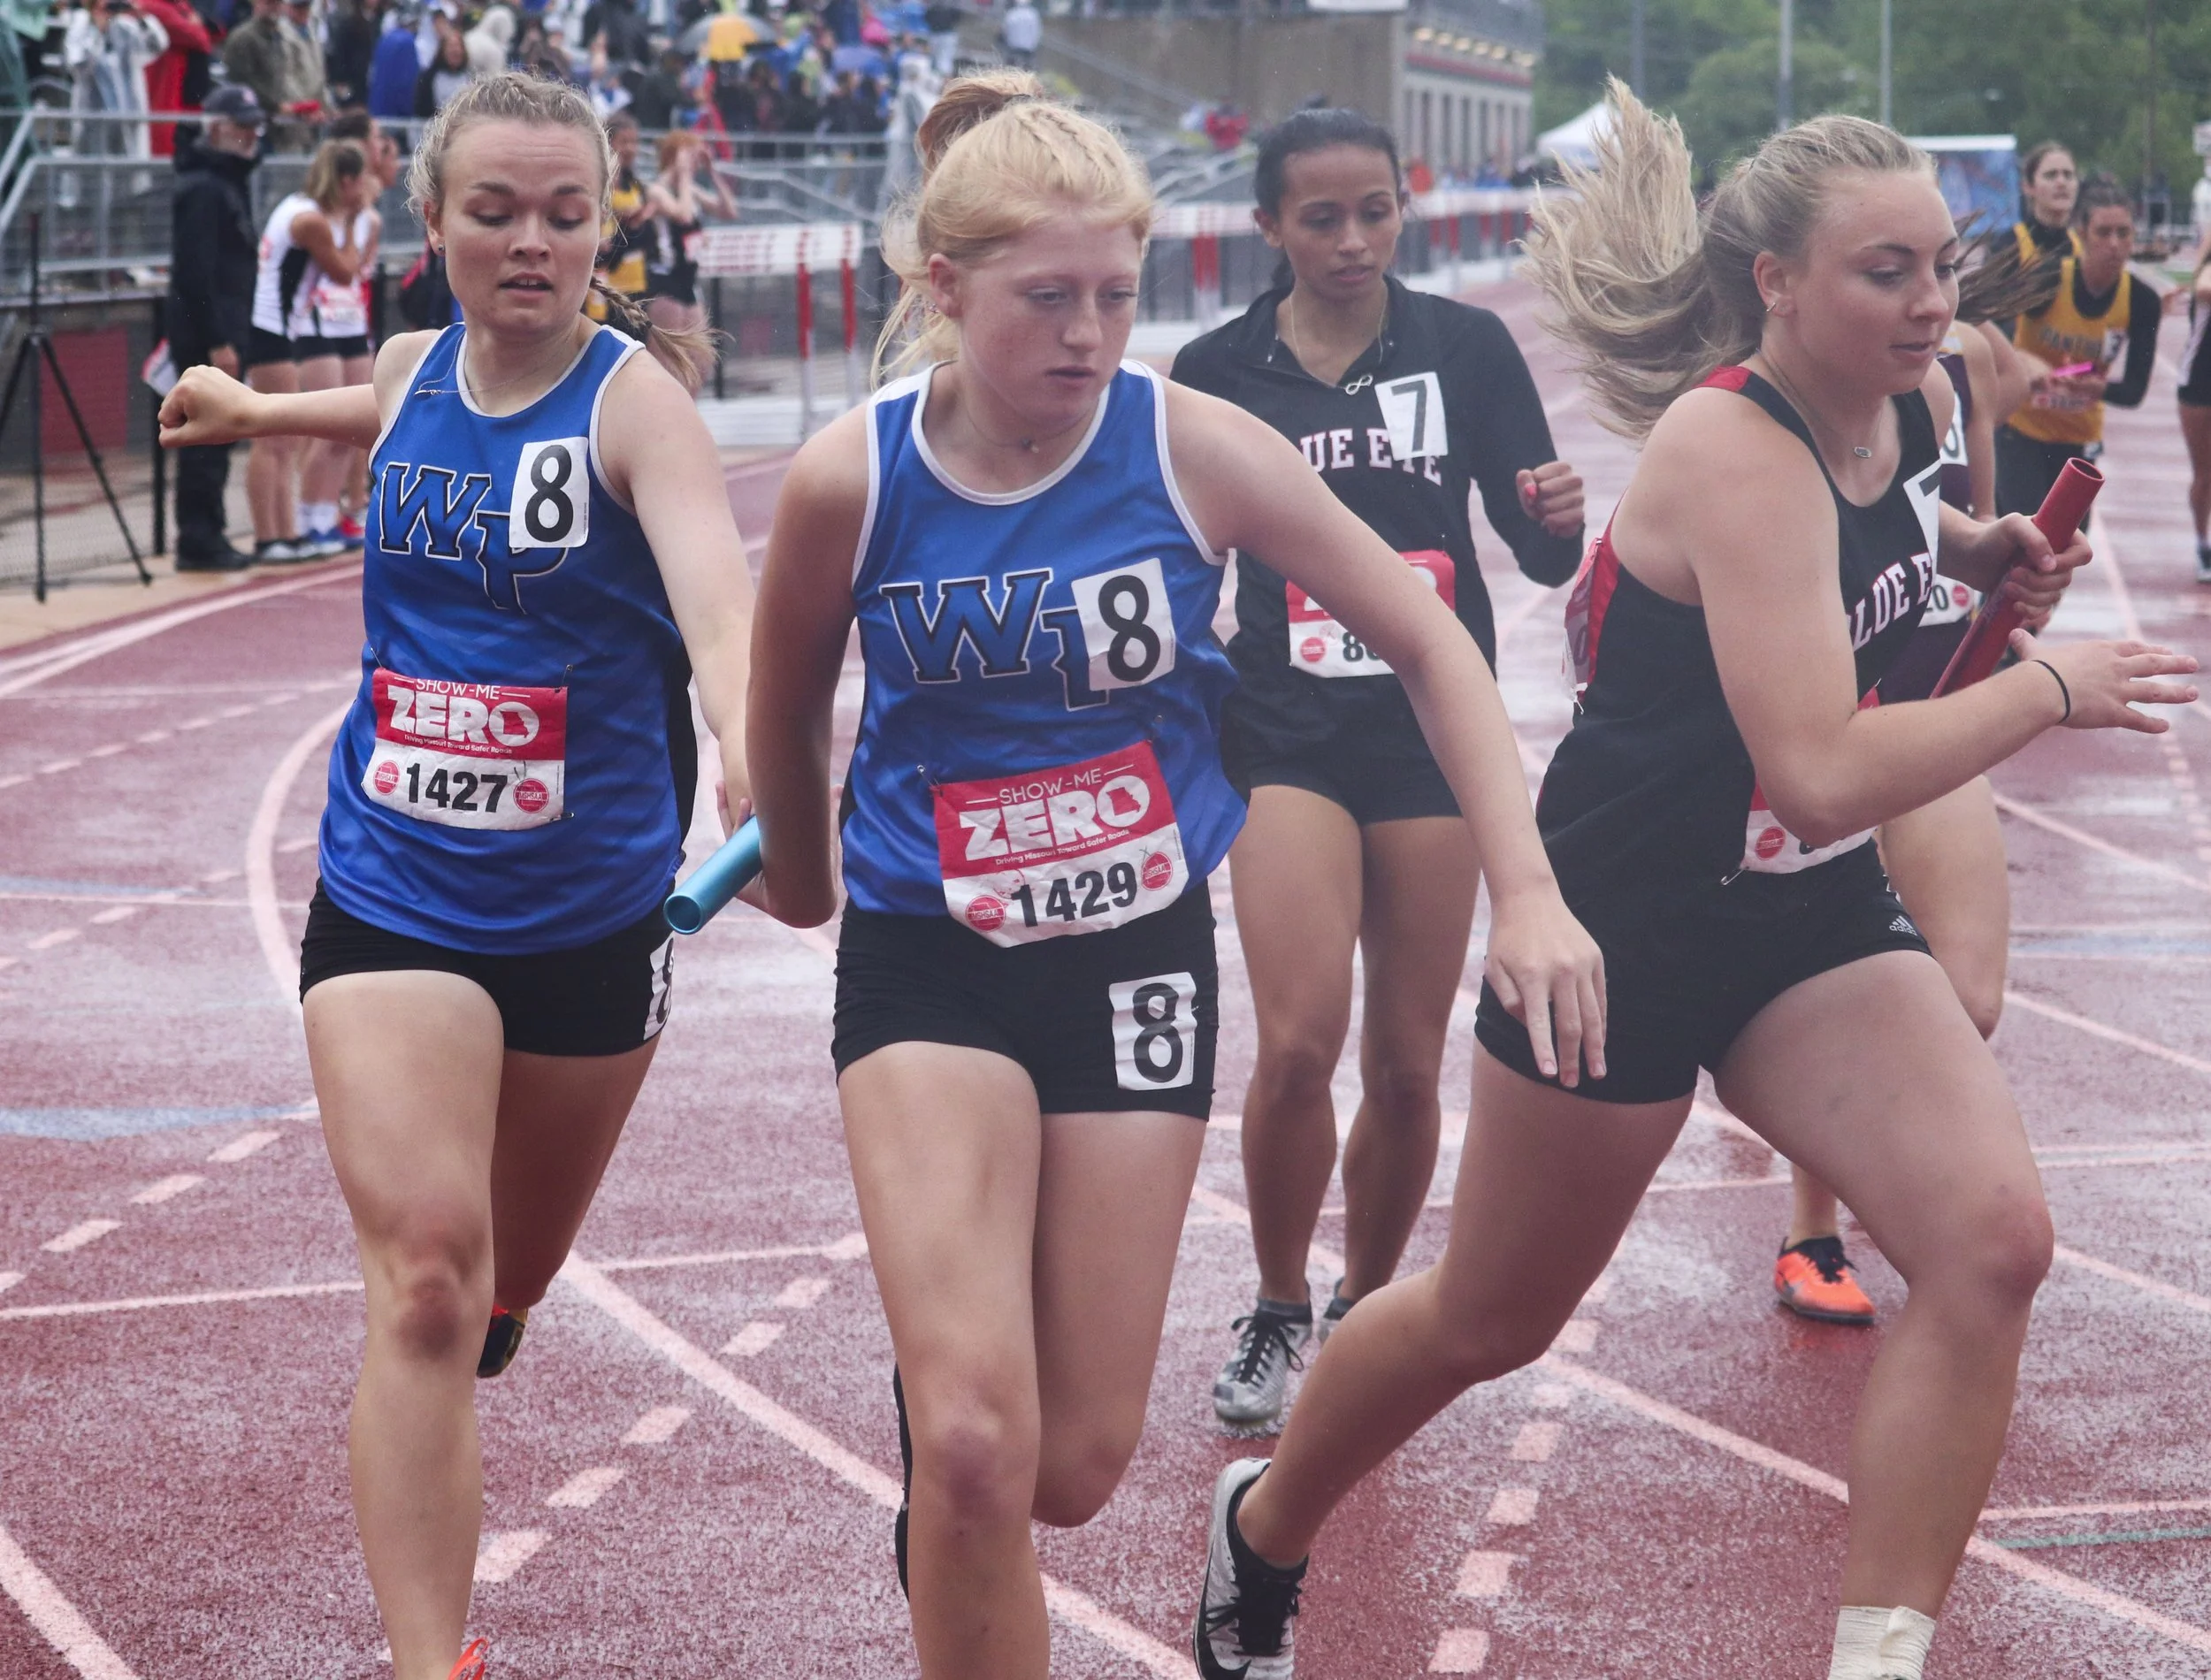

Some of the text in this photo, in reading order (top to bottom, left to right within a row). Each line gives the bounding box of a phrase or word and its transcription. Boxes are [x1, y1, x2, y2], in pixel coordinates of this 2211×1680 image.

[1391, 379, 1427, 453] 7
[1300, 428, 1355, 473] UE
[524, 445, 574, 542] 8
[1098, 574, 1161, 682] 8
[1846, 561, 1909, 653] LUE
[387, 684, 539, 747] ZERO
[416, 678, 501, 700] SHOW-ME
[407, 763, 508, 813] 1427
[960, 775, 1150, 861] ZERO
[998, 768, 1102, 805] SHOW-ME
[995, 829, 1129, 867] Driving Missouri Toward Safer Roads
[1011, 862, 1138, 928] 1429
[1132, 982, 1183, 1083] 8
